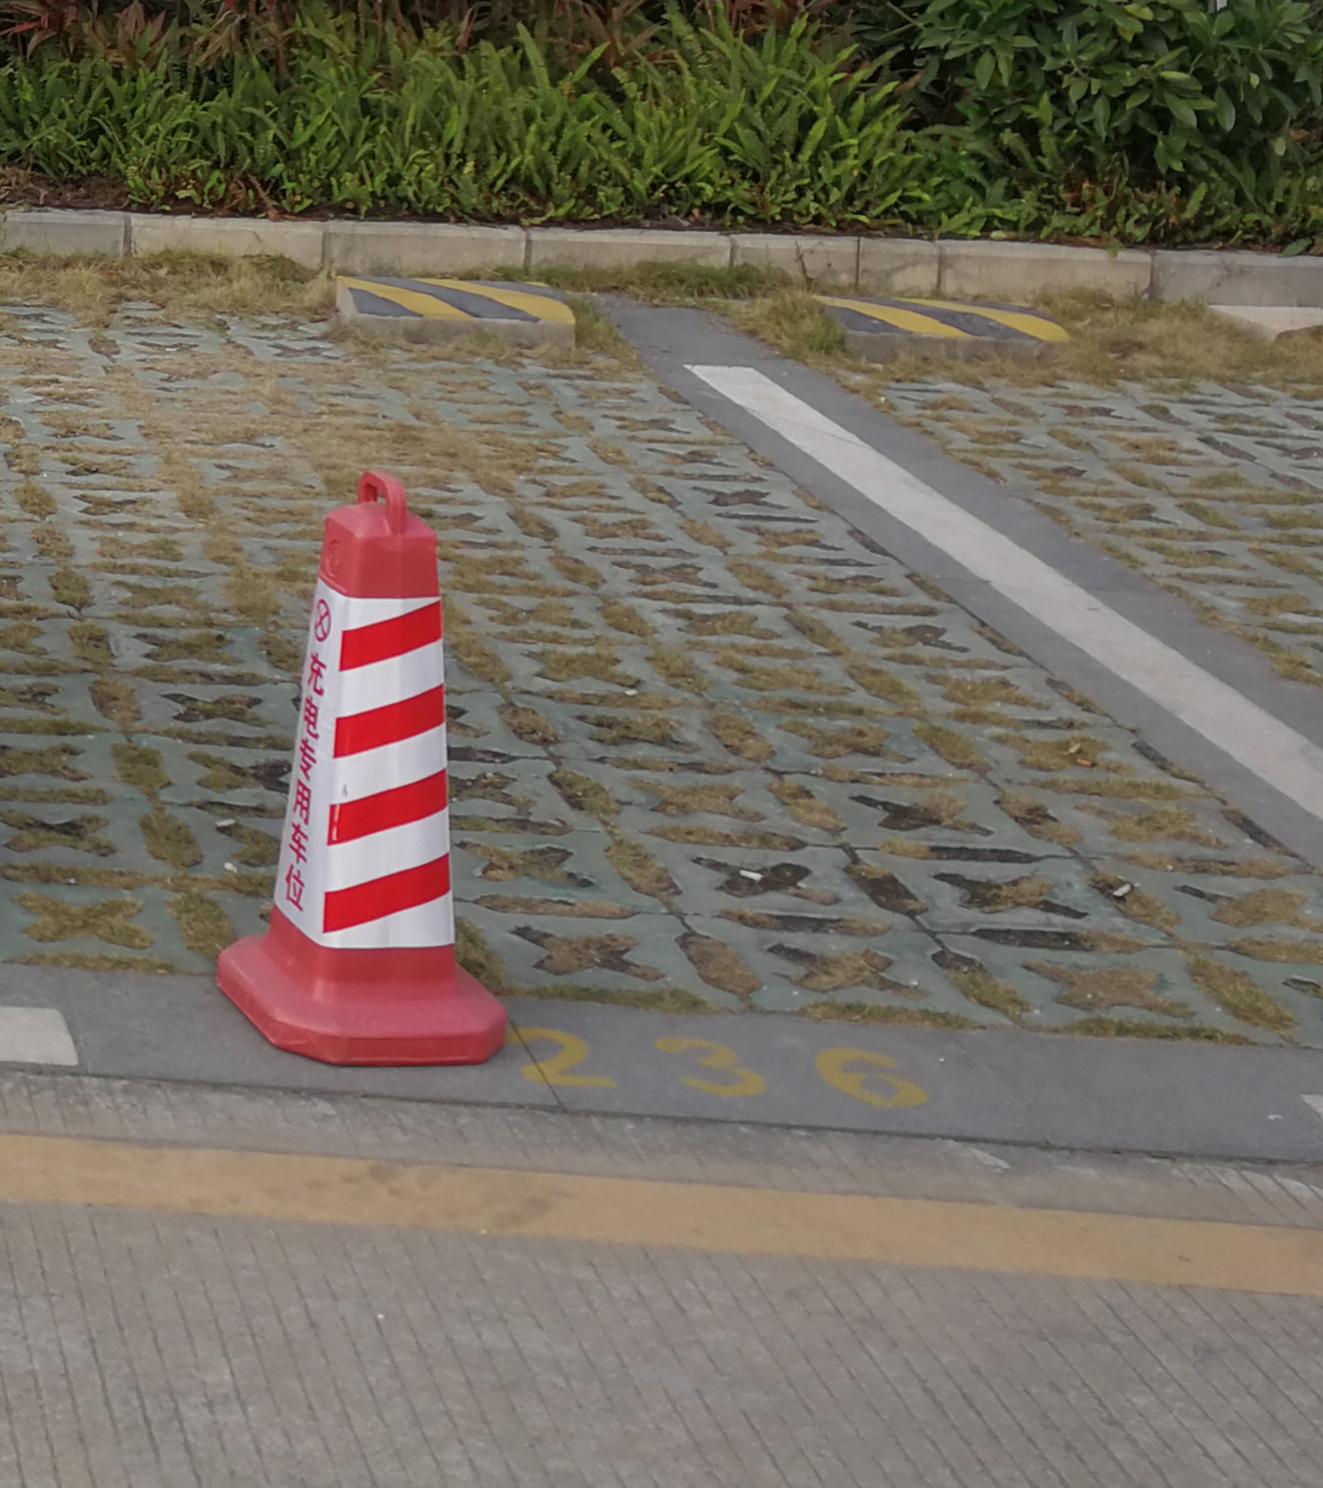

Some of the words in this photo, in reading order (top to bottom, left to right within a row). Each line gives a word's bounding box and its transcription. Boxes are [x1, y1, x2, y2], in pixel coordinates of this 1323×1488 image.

[284, 652, 327, 913] 充电专用车位
[506, 1027, 930, 1109] 236
